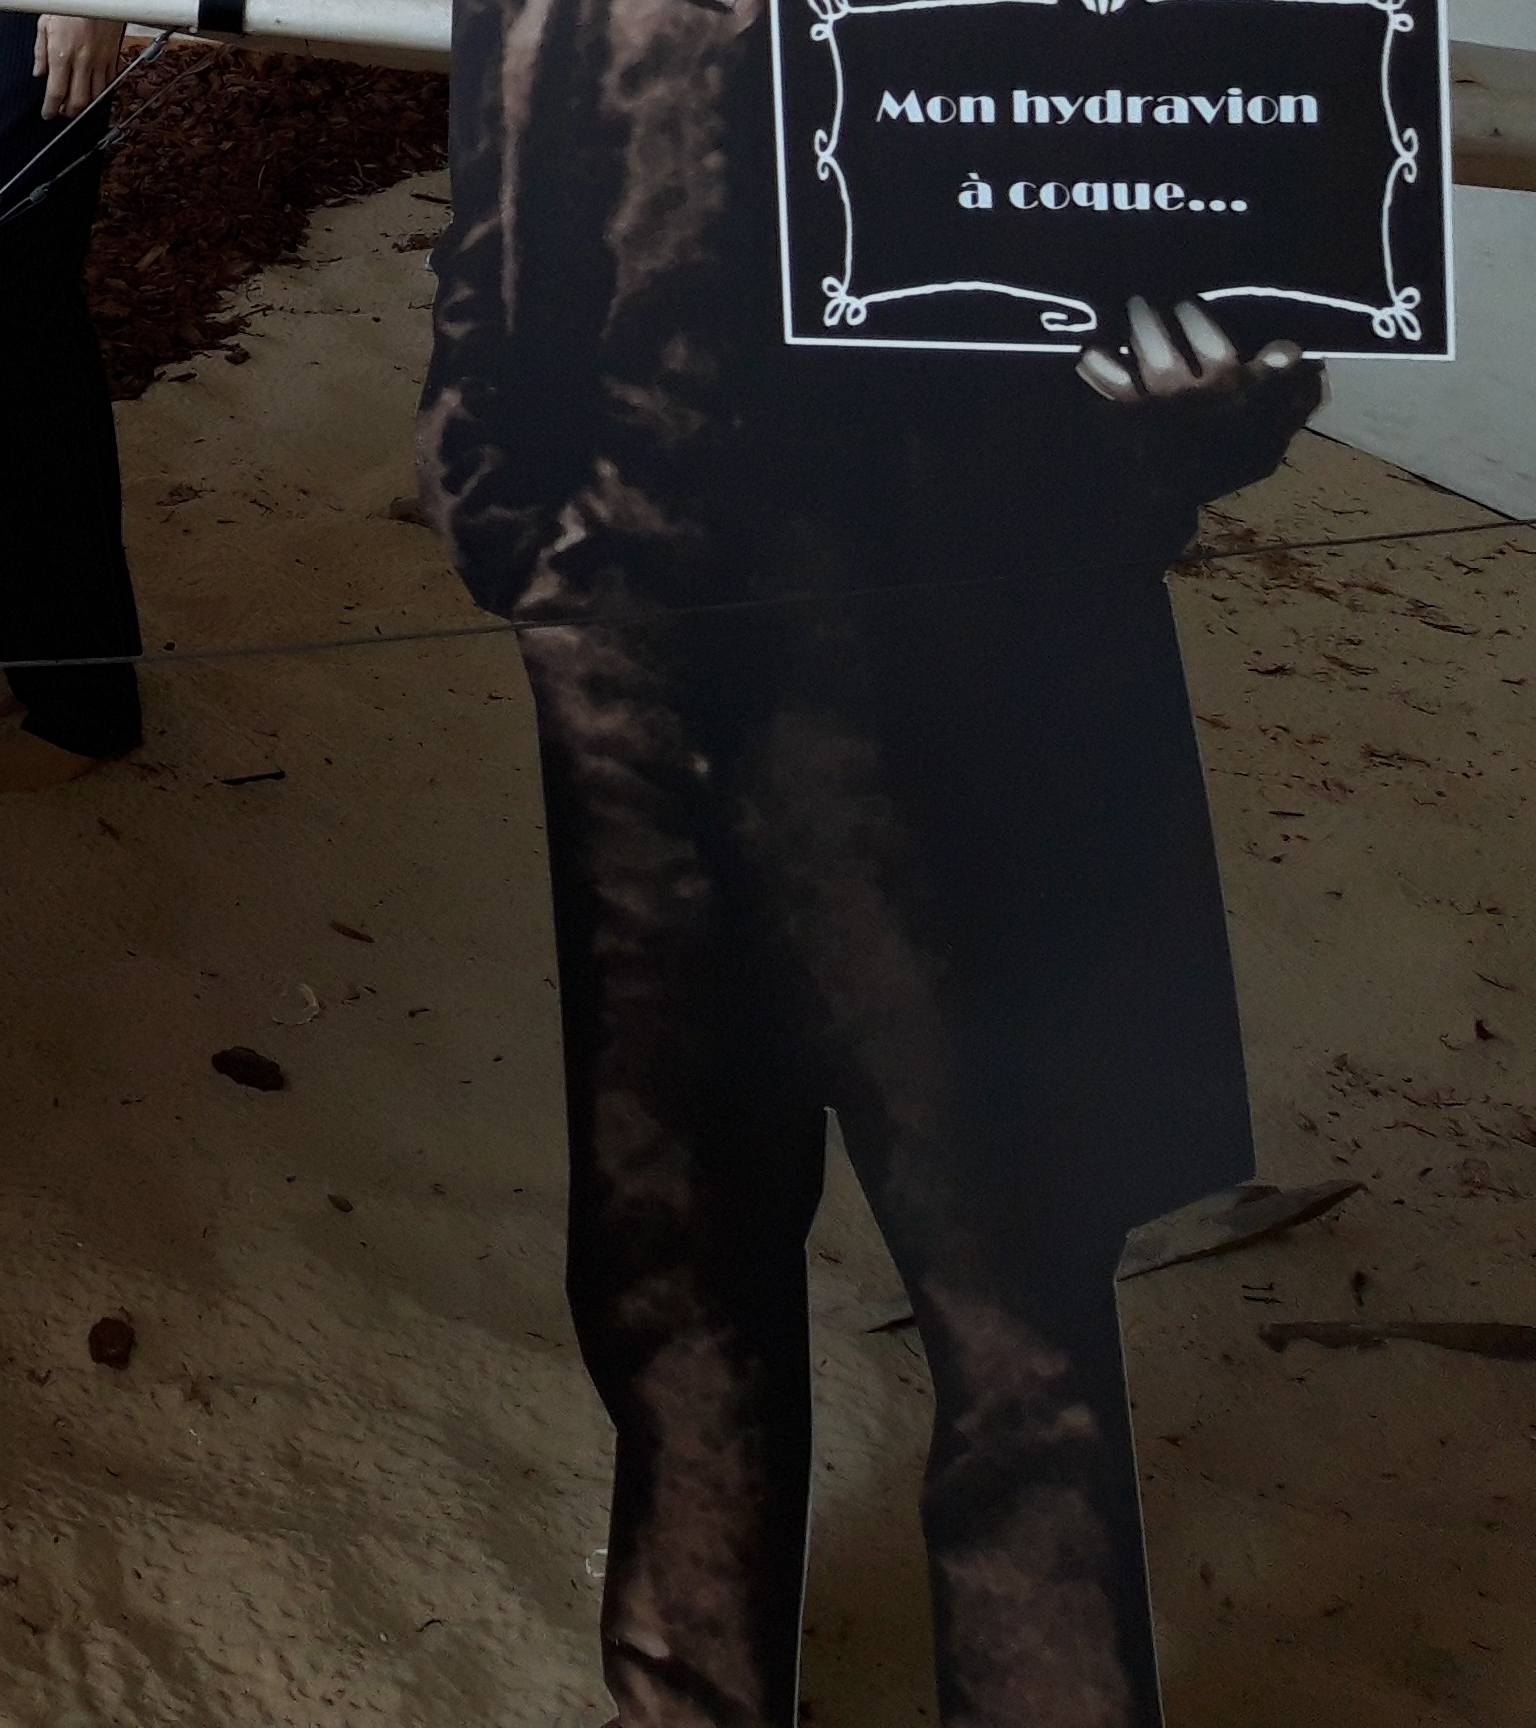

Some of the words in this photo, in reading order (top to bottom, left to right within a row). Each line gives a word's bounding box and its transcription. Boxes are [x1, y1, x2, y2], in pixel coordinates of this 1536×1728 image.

[875, 89, 995, 124] Mon
[1012, 87, 1319, 125] hydravion
[957, 172, 994, 210] à
[1008, 180, 1248, 212] coque...
